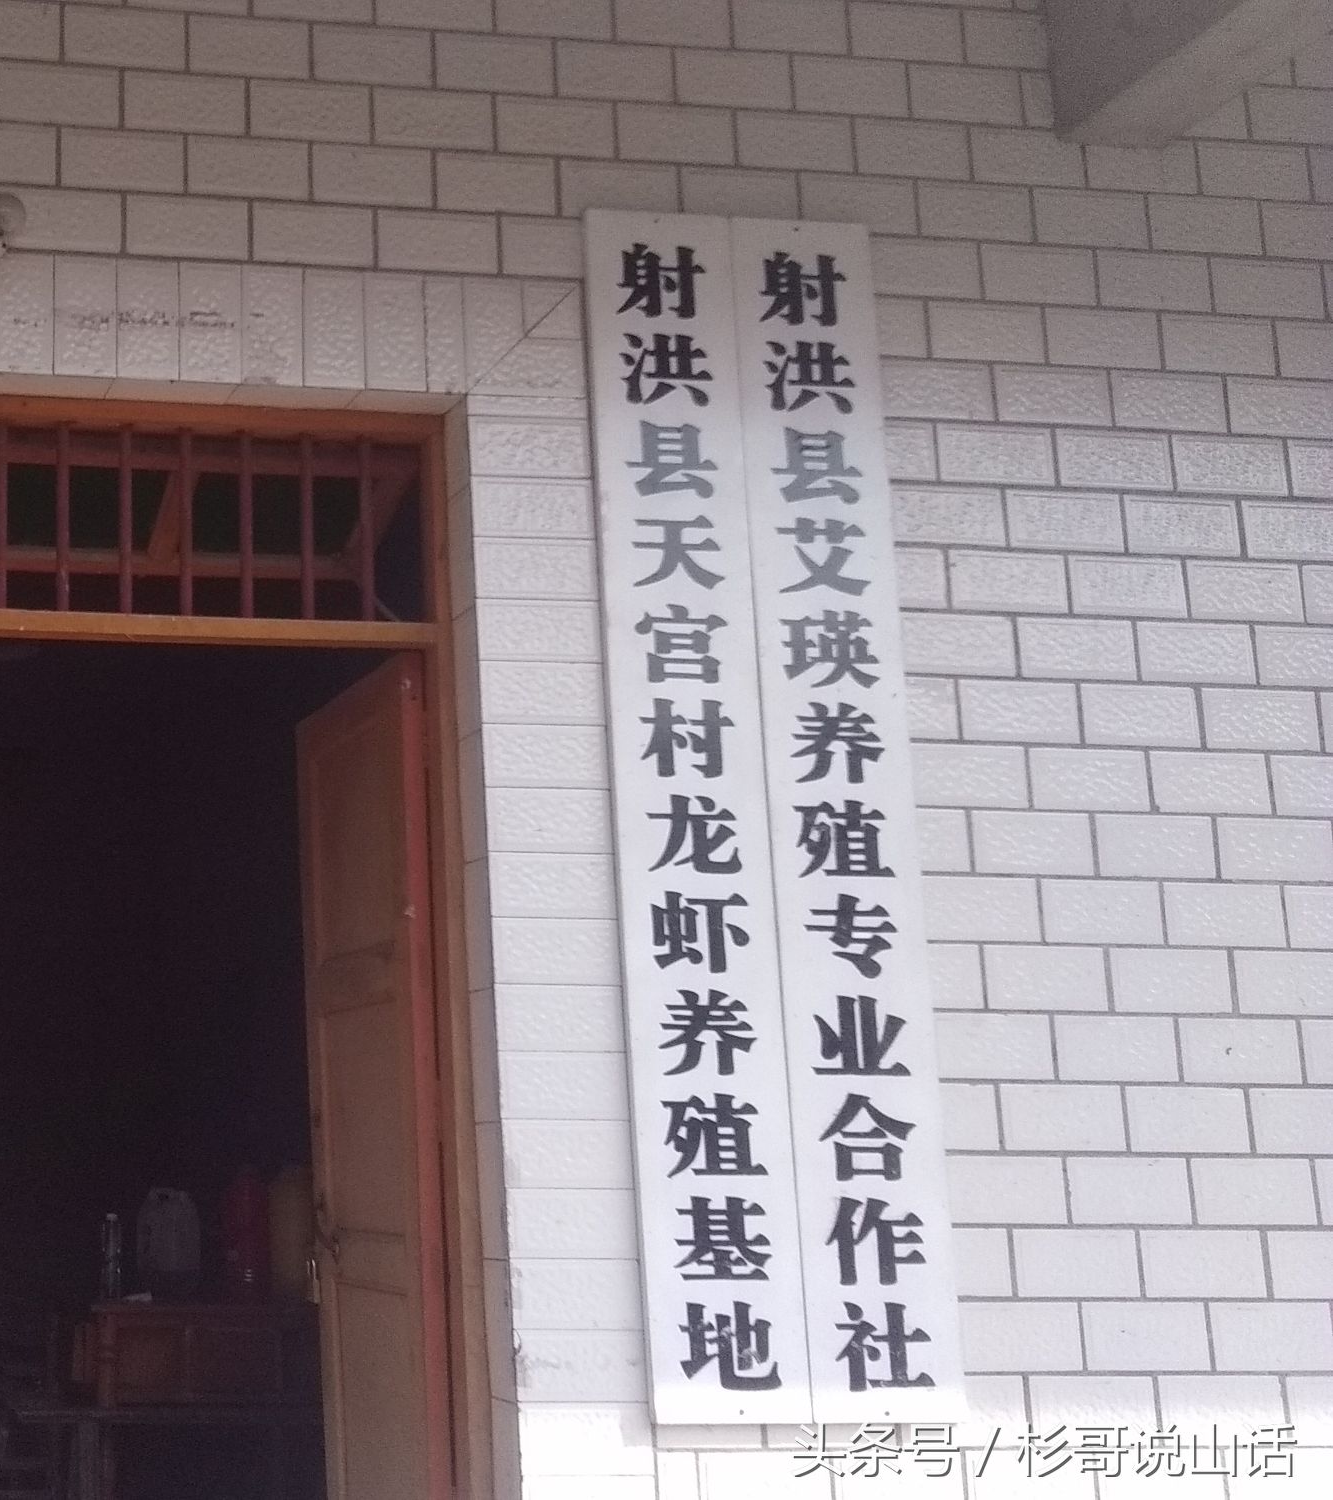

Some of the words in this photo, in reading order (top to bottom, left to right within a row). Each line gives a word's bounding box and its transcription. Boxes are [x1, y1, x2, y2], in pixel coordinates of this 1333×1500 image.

[616, 242, 782, 1392] 射洪县天宫村龙虾养殖基地
[760, 251, 935, 1392] 射洪县艾瑛养殖专业合作社
